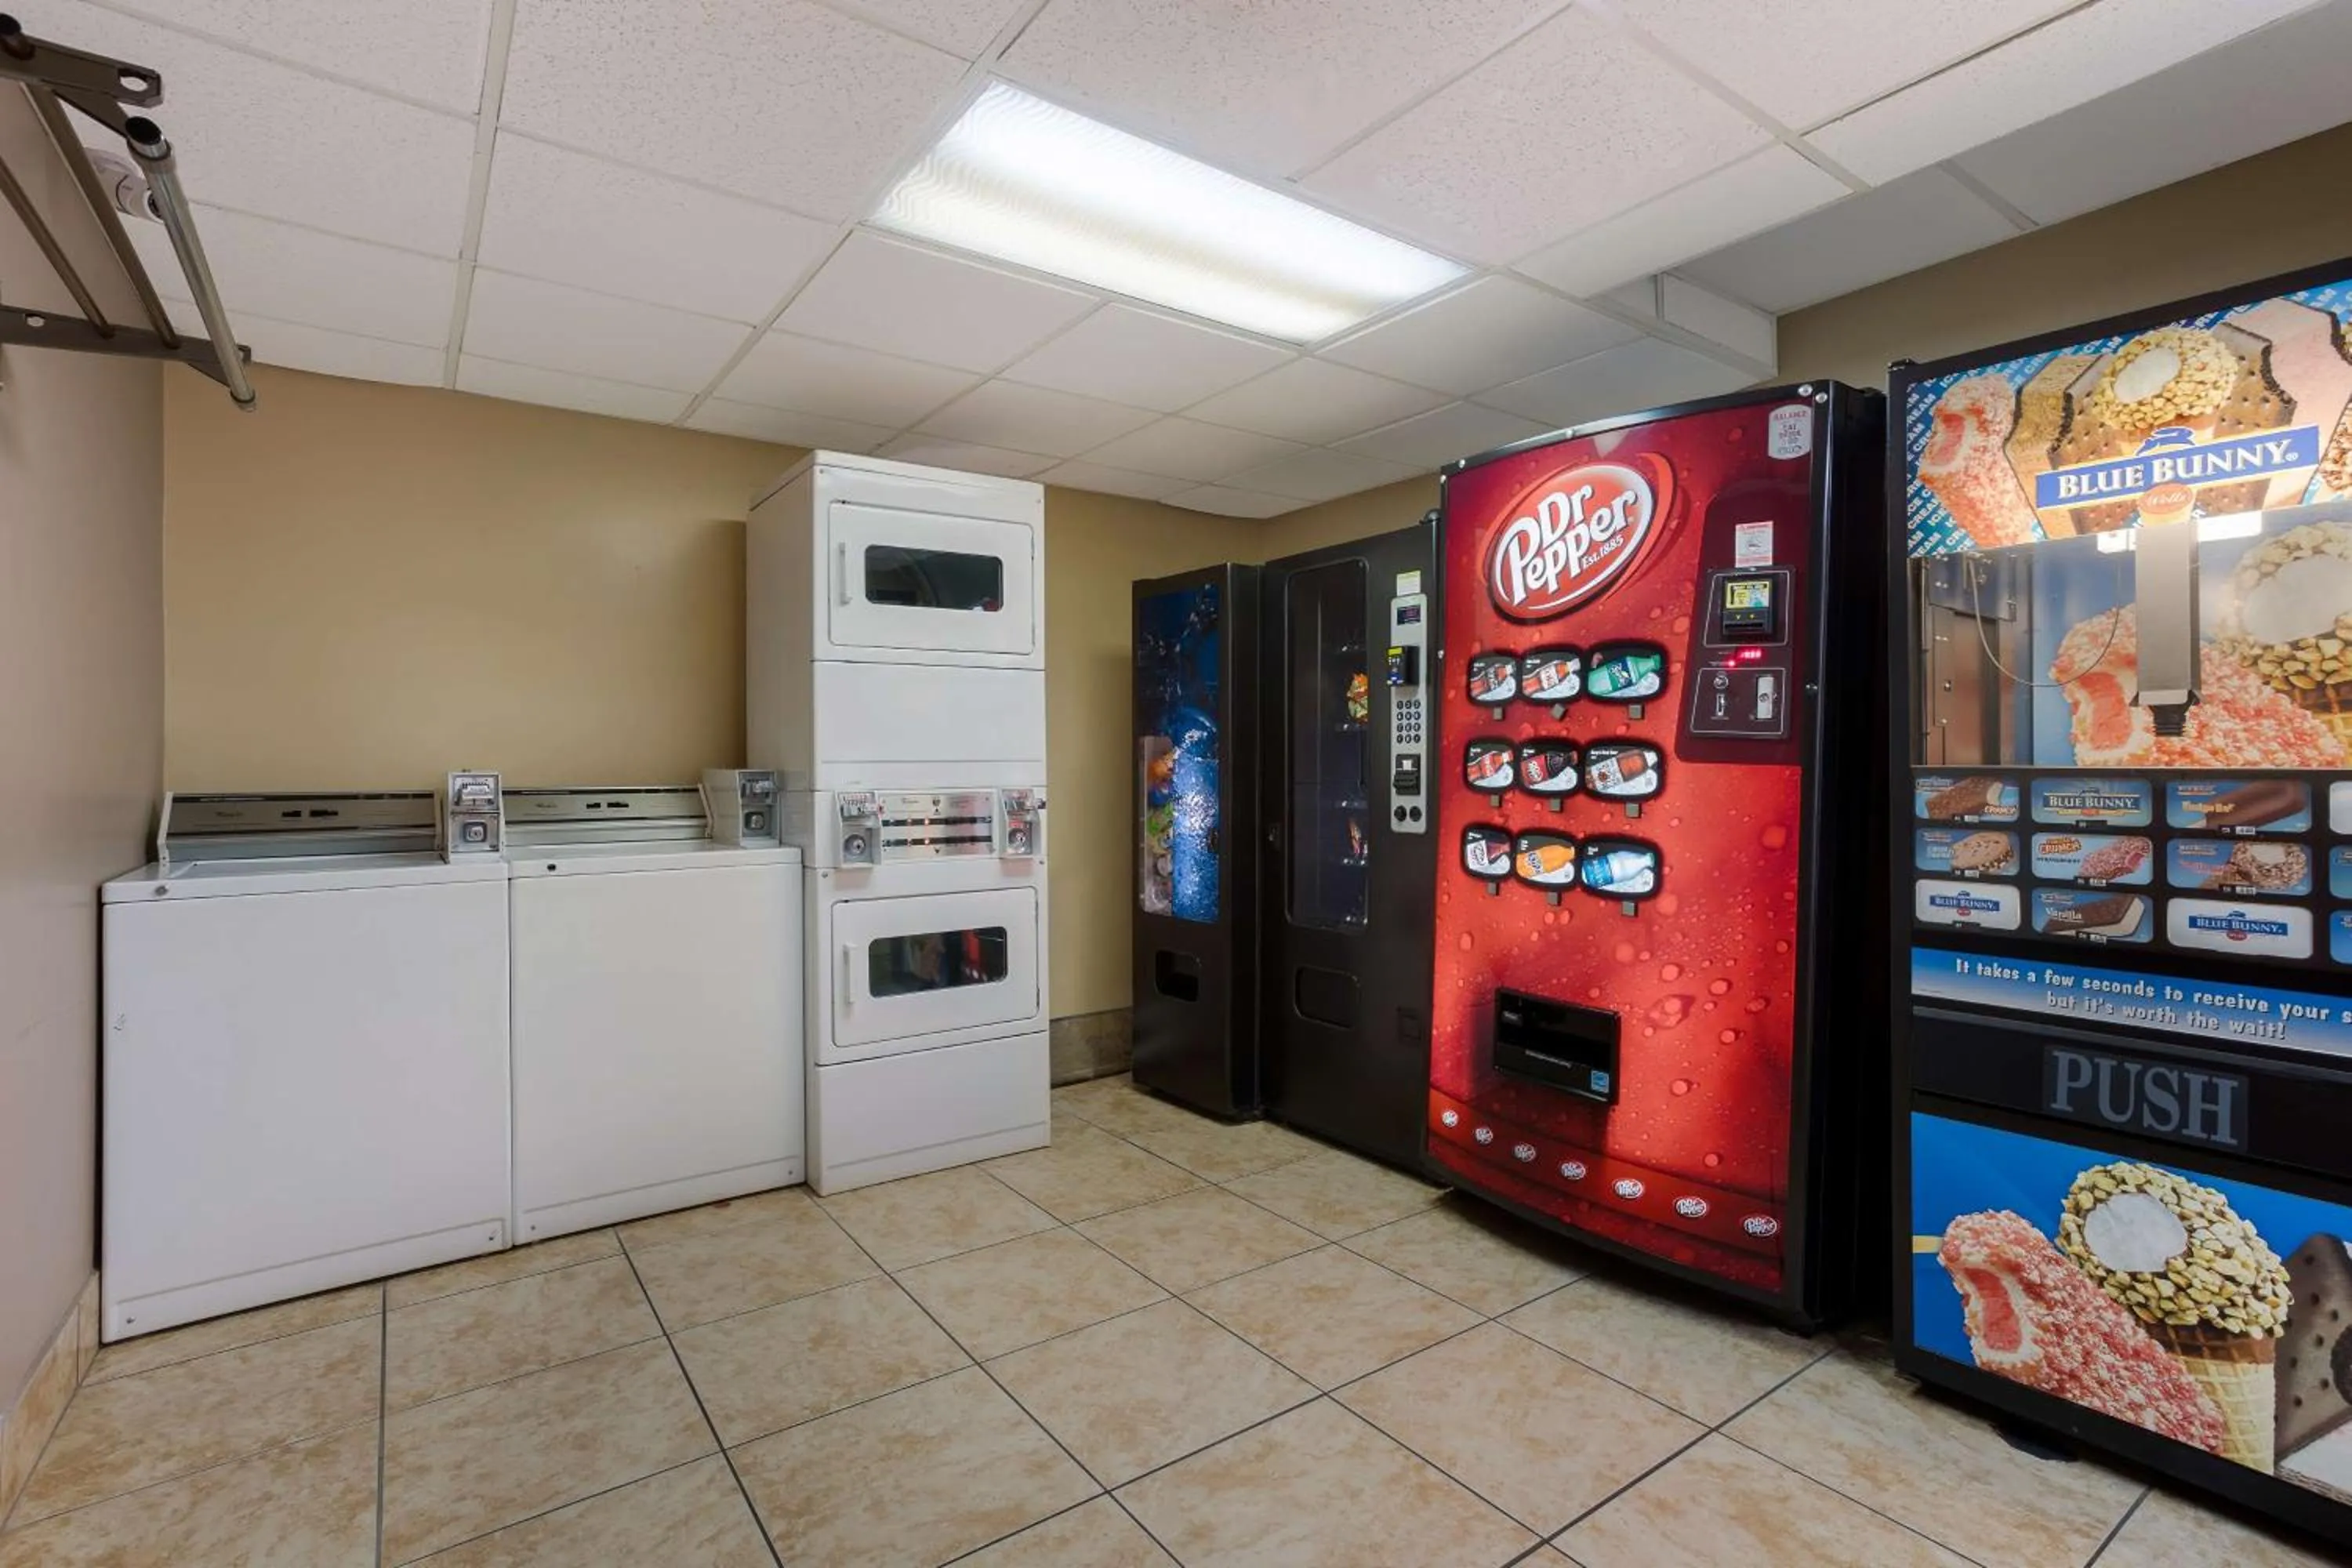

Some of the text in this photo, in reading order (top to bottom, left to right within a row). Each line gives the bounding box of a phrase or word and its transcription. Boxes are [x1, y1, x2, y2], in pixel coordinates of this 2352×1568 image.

[2057, 463, 2144, 499] BLUE
[1537, 485, 1594, 548] Dr
[1496, 490, 1638, 606] Pepper
[2049, 795, 2083, 808] BLUE
[2195, 917, 2229, 930] BLUE
[1956, 957, 1969, 973] It
[1976, 963, 2020, 980] takes
[2027, 971, 2036, 983] a
[2044, 969, 2074, 988] few
[2082, 978, 2155, 998] seconds
[2164, 985, 2183, 1001] to
[2193, 992, 2270, 1013] receive
[2280, 1003, 2330, 1021] your
[2047, 991, 2285, 1040] but it's worth the wait!
[2049, 1050, 2239, 1145] PUSH
